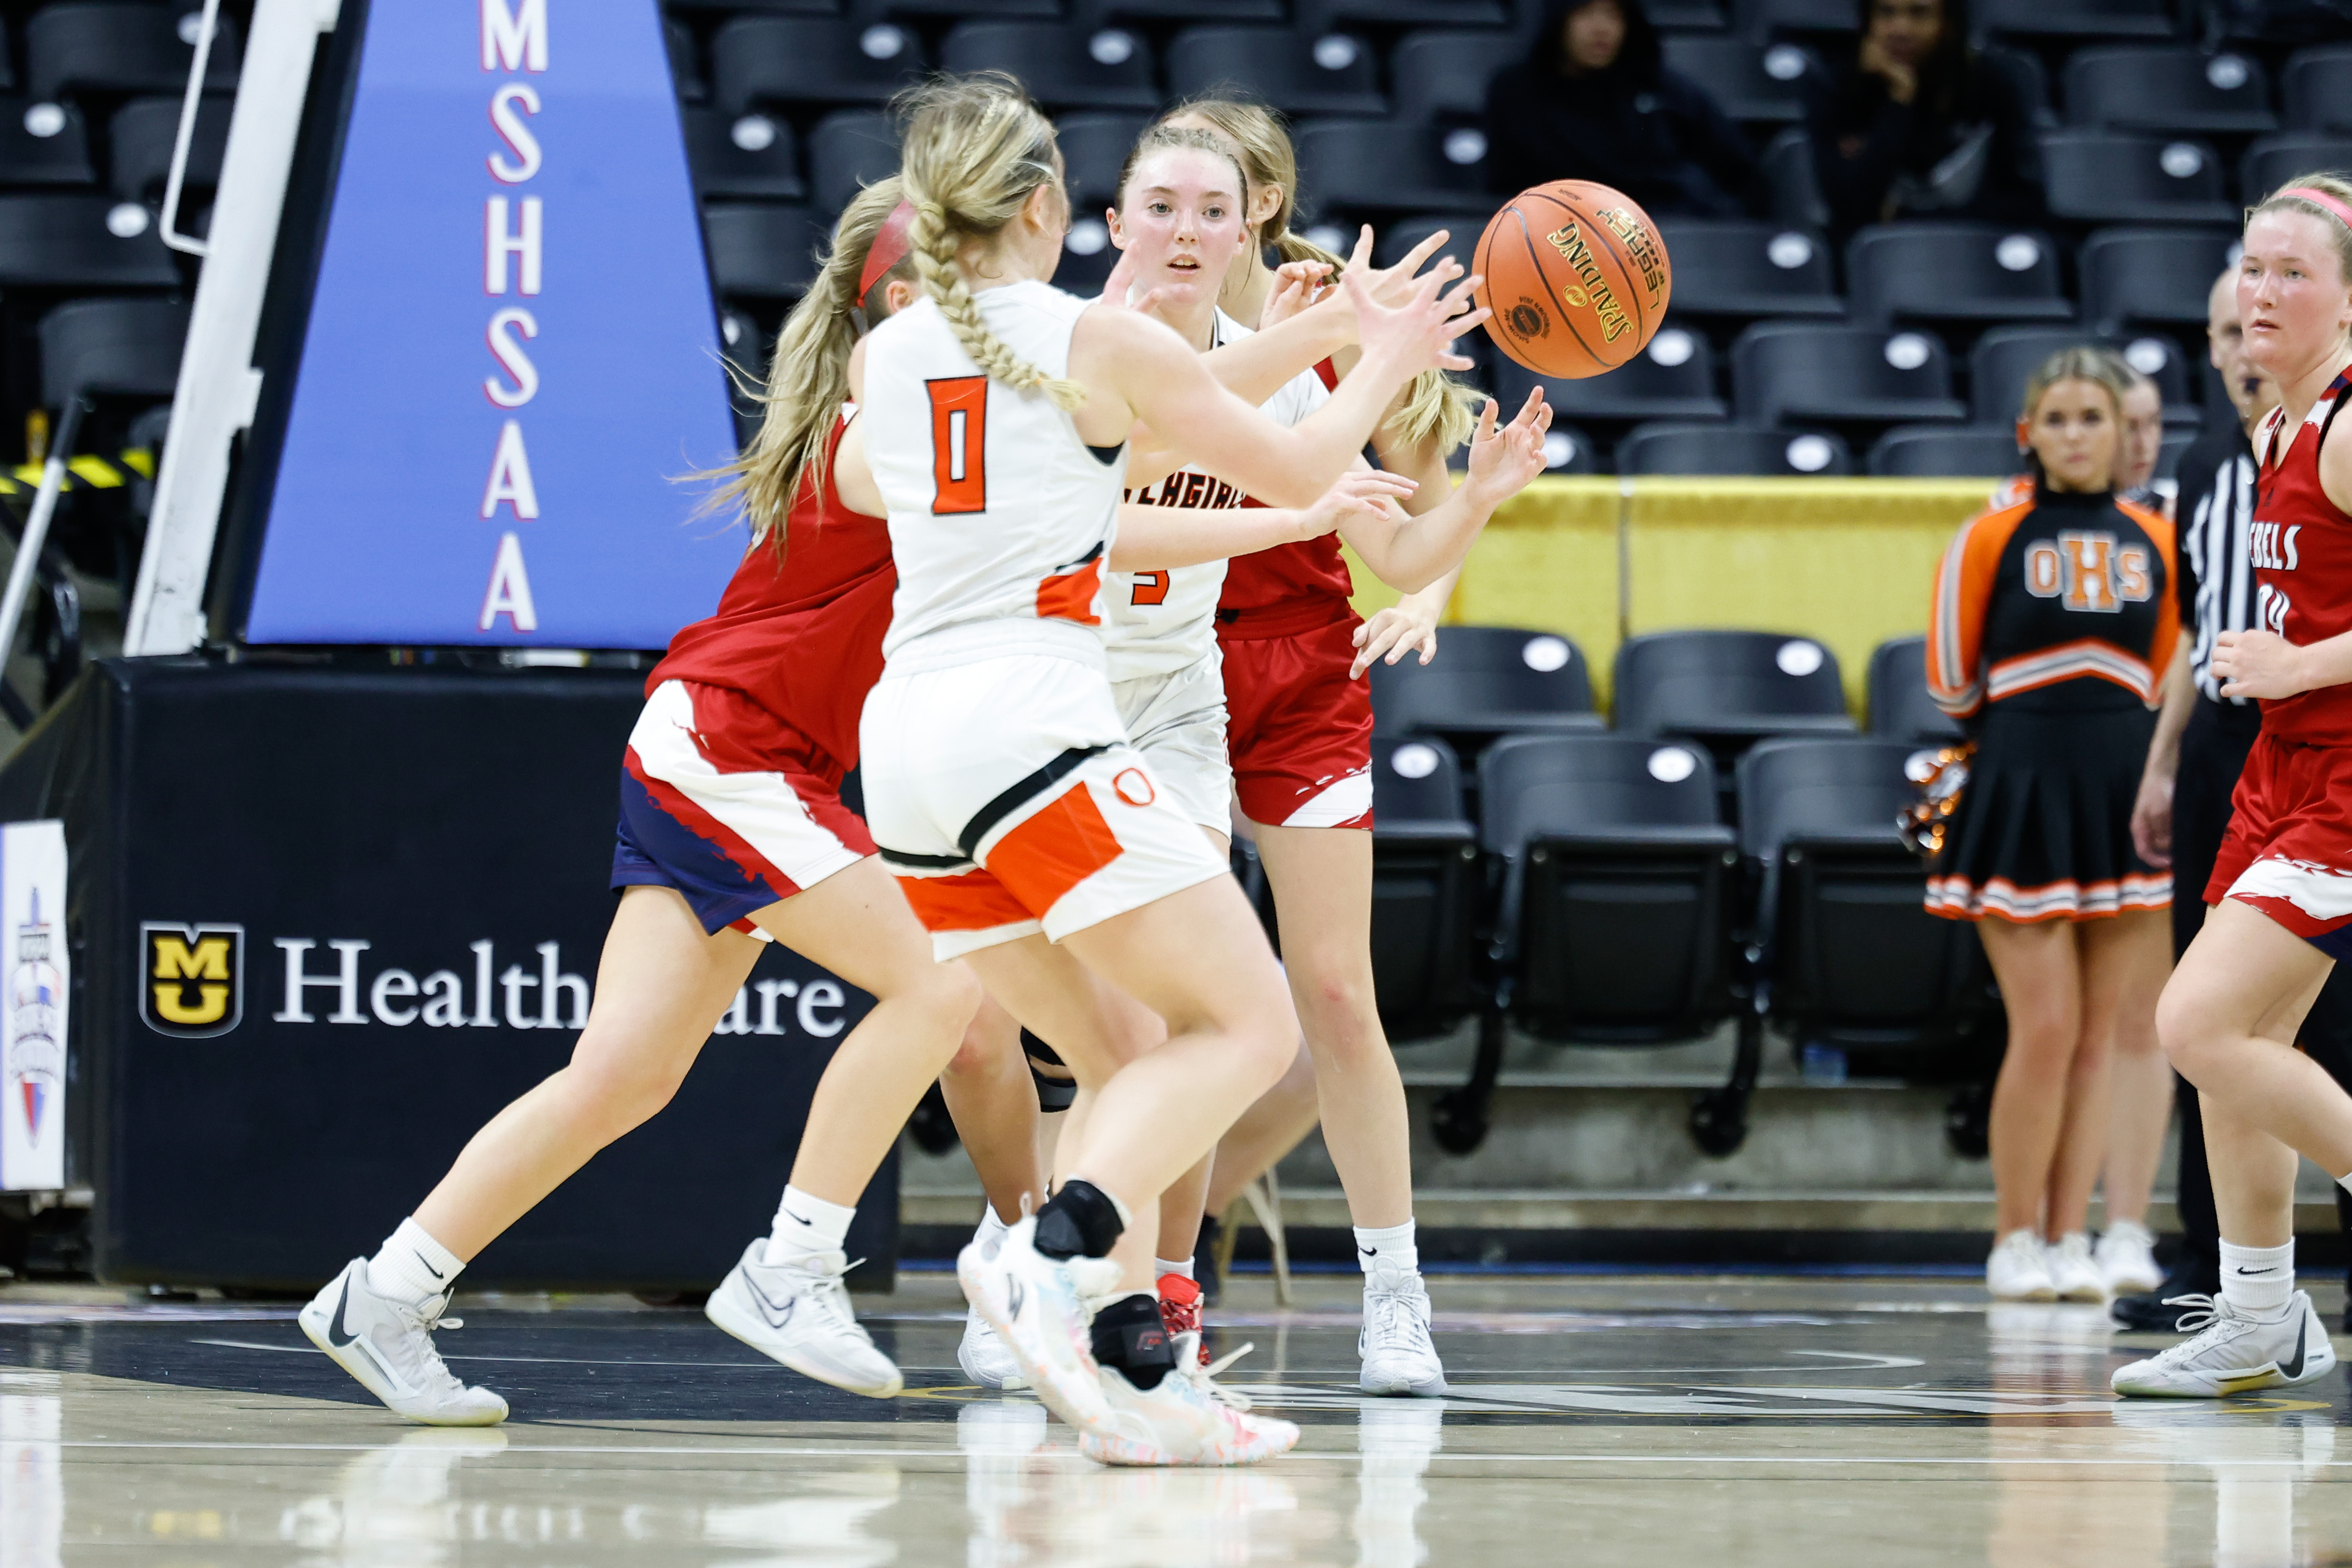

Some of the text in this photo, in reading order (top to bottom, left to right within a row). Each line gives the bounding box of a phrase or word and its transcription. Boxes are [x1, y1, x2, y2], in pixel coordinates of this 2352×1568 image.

[1546, 222, 1634, 344] SPALDING
[1594, 209, 1660, 311] LEGACY
[478, 0, 549, 634] MSHSAA
[924, 374, 988, 517] 0
[2024, 530, 2153, 614] OHS
[153, 936, 230, 1024] MU
[273, 937, 590, 1030] Health
[713, 977, 846, 1038] are
